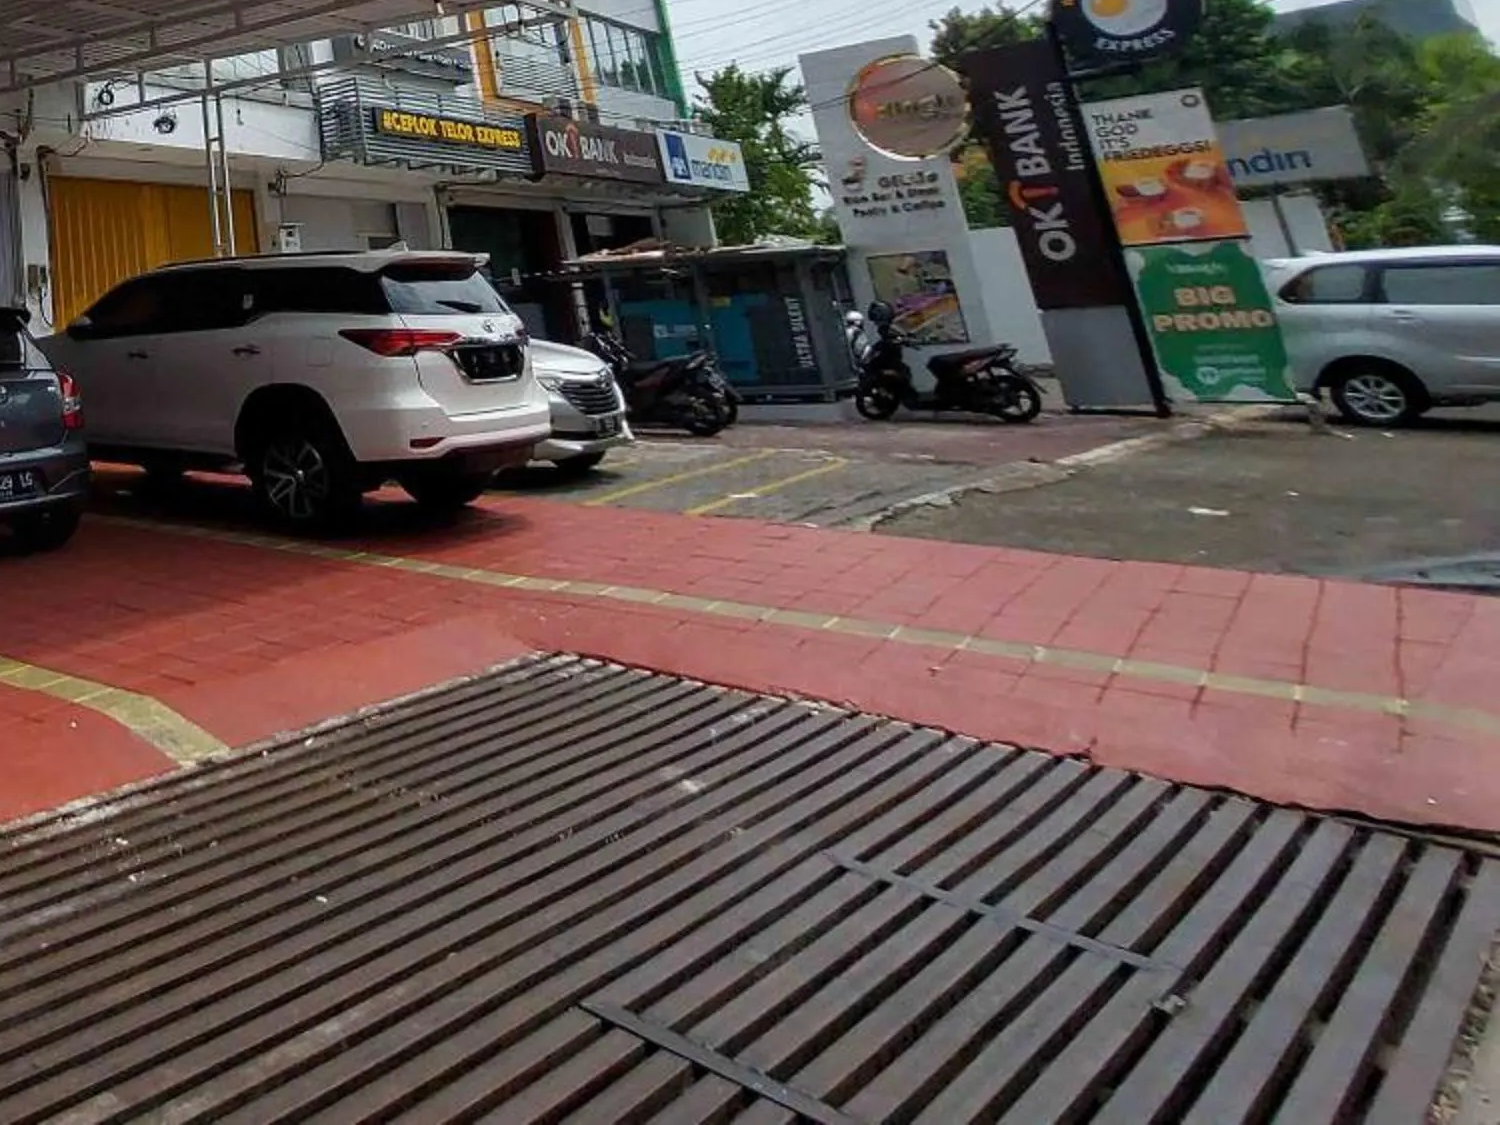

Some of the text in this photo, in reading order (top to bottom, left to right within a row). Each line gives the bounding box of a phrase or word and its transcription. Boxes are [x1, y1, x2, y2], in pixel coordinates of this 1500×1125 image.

[1093, 28, 1177, 52] EXPRESS
[1092, 108, 1154, 125] THANK
[440, 120, 475, 142] TELOR
[477, 126, 521, 148] EXPRESS
[993, 85, 1051, 177] BANK
[1095, 123, 1138, 138] GOD
[1174, 285, 1237, 307] BIG
[1152, 309, 1275, 332] PROMO
